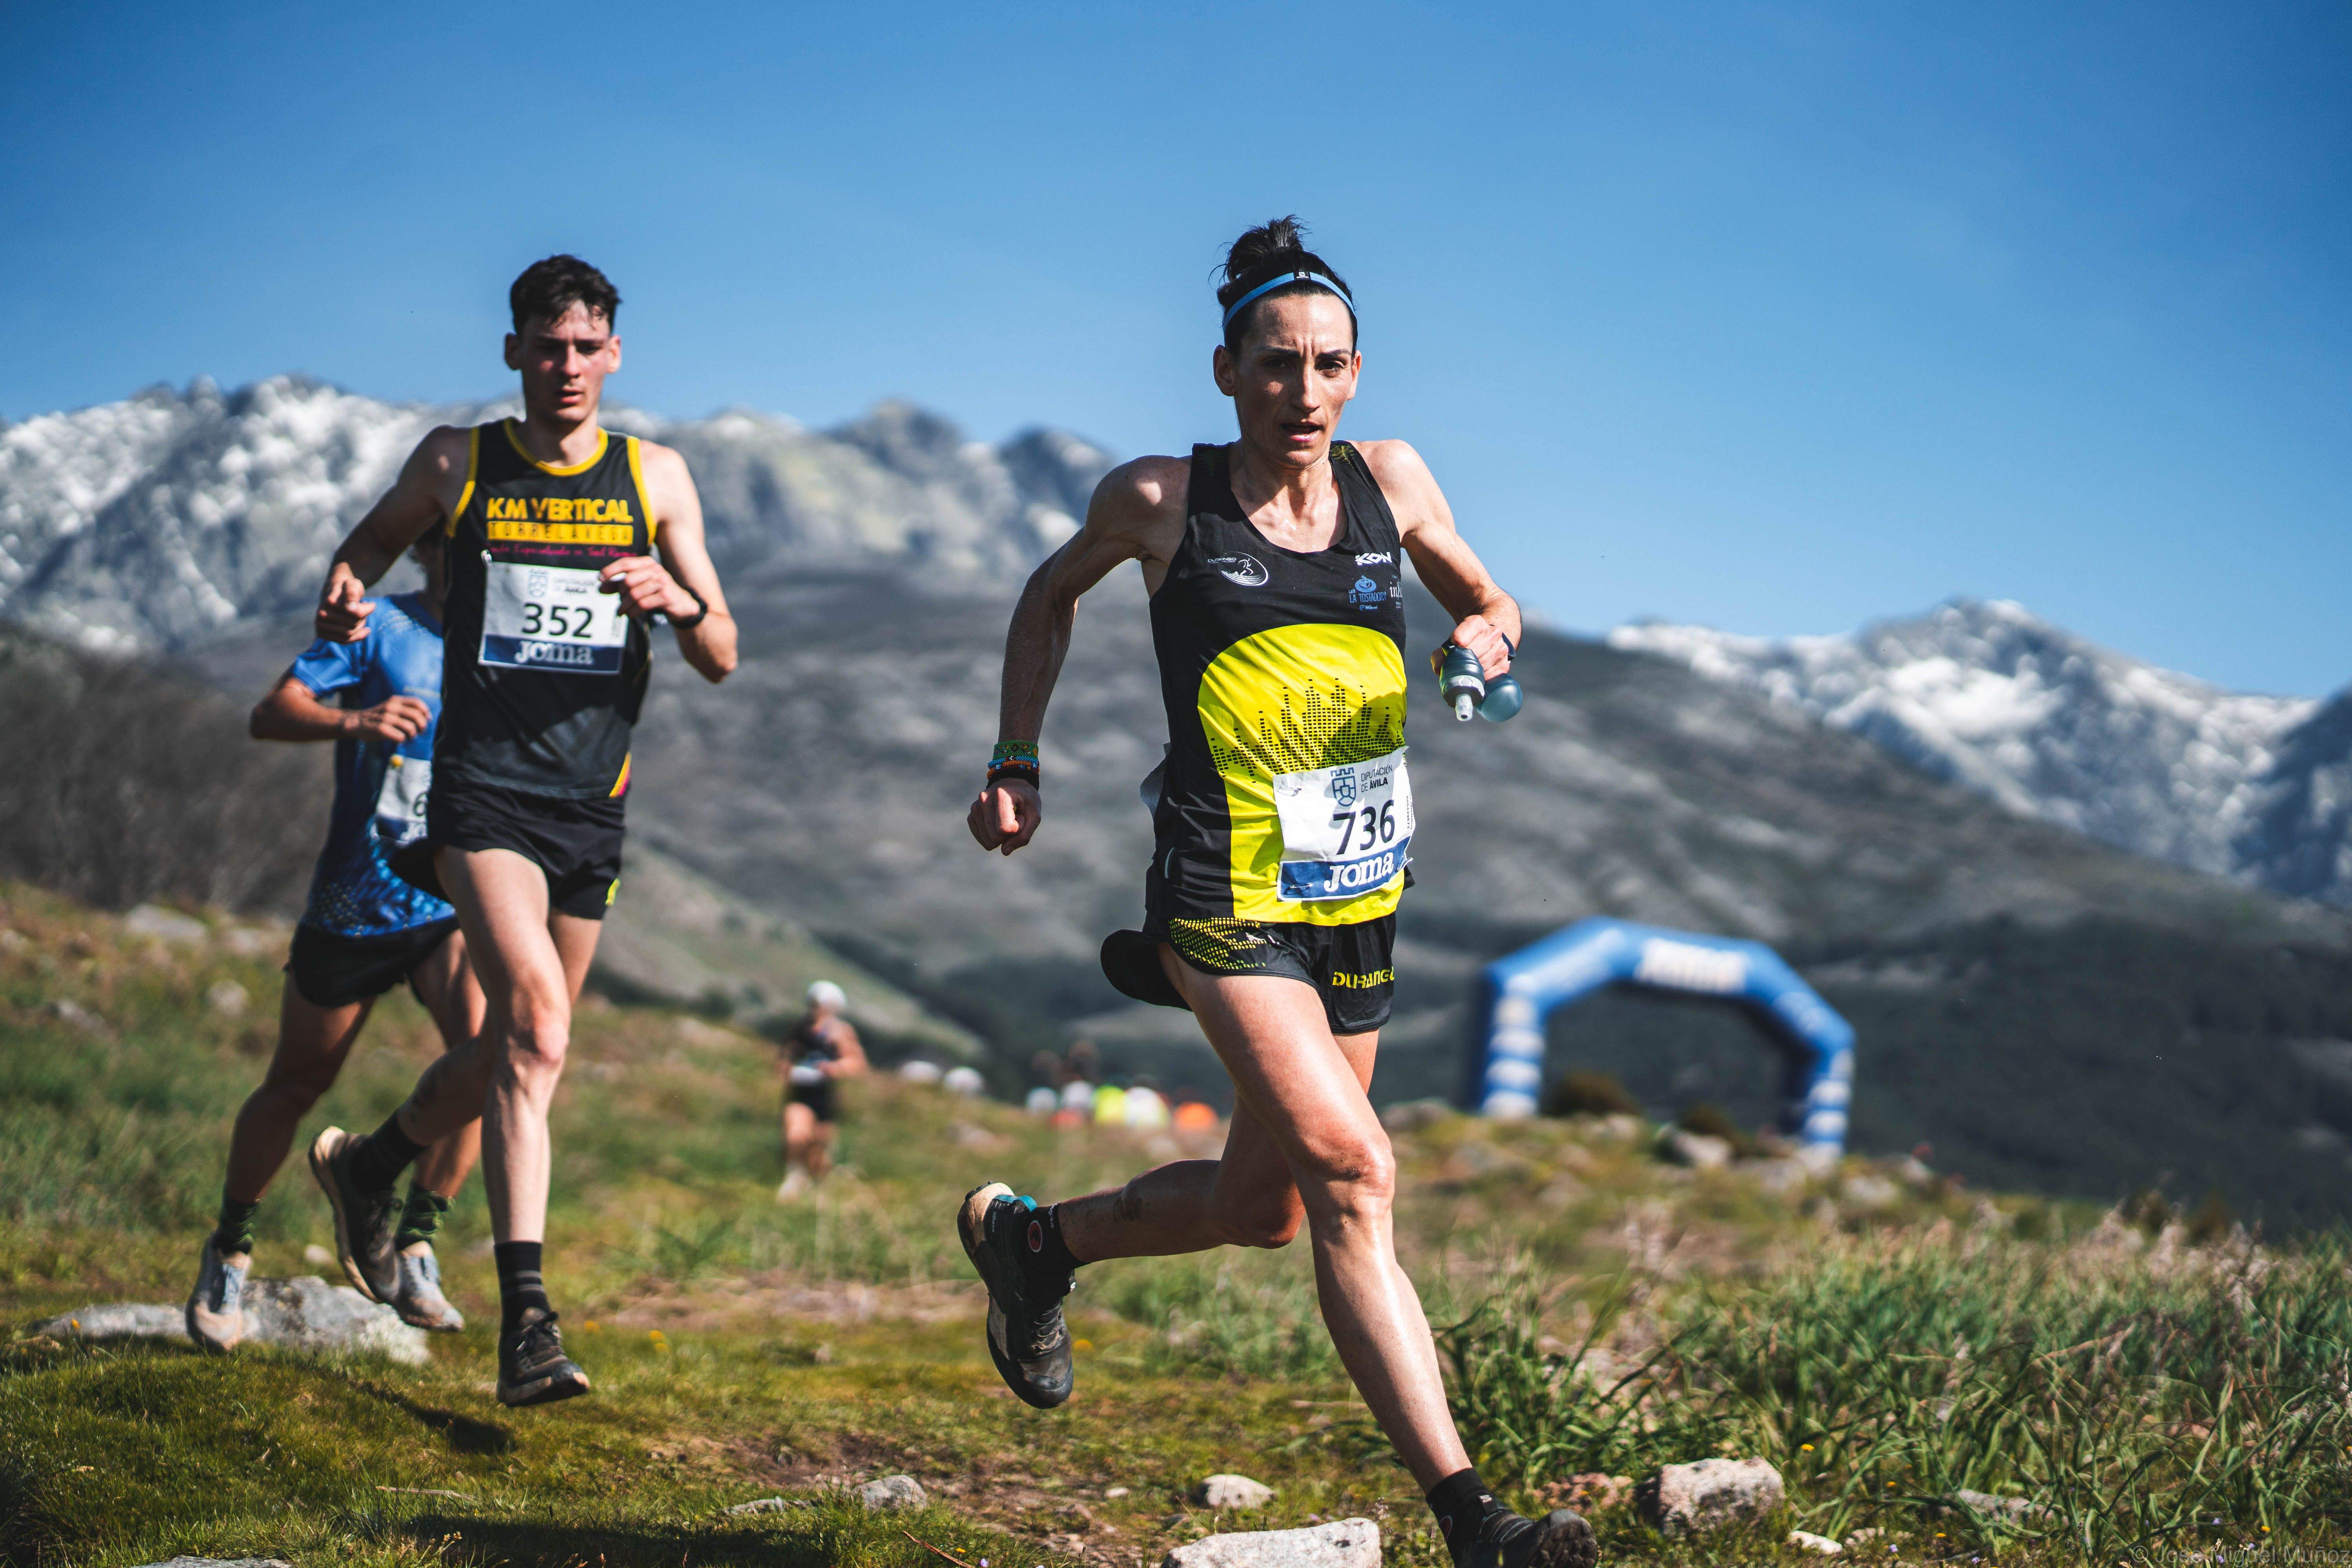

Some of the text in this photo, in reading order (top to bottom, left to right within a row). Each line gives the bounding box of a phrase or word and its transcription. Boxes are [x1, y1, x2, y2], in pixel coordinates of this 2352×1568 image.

[486, 497, 634, 523] KM VERTICAL
[1349, 591, 1387, 603] LA TOSTADORA
[521, 602, 593, 638] 352
[1361, 764, 1392, 782] DIPUTACIÓN
[1361, 777, 1388, 792] DE ÁVILA
[1333, 799, 1395, 855] 736
